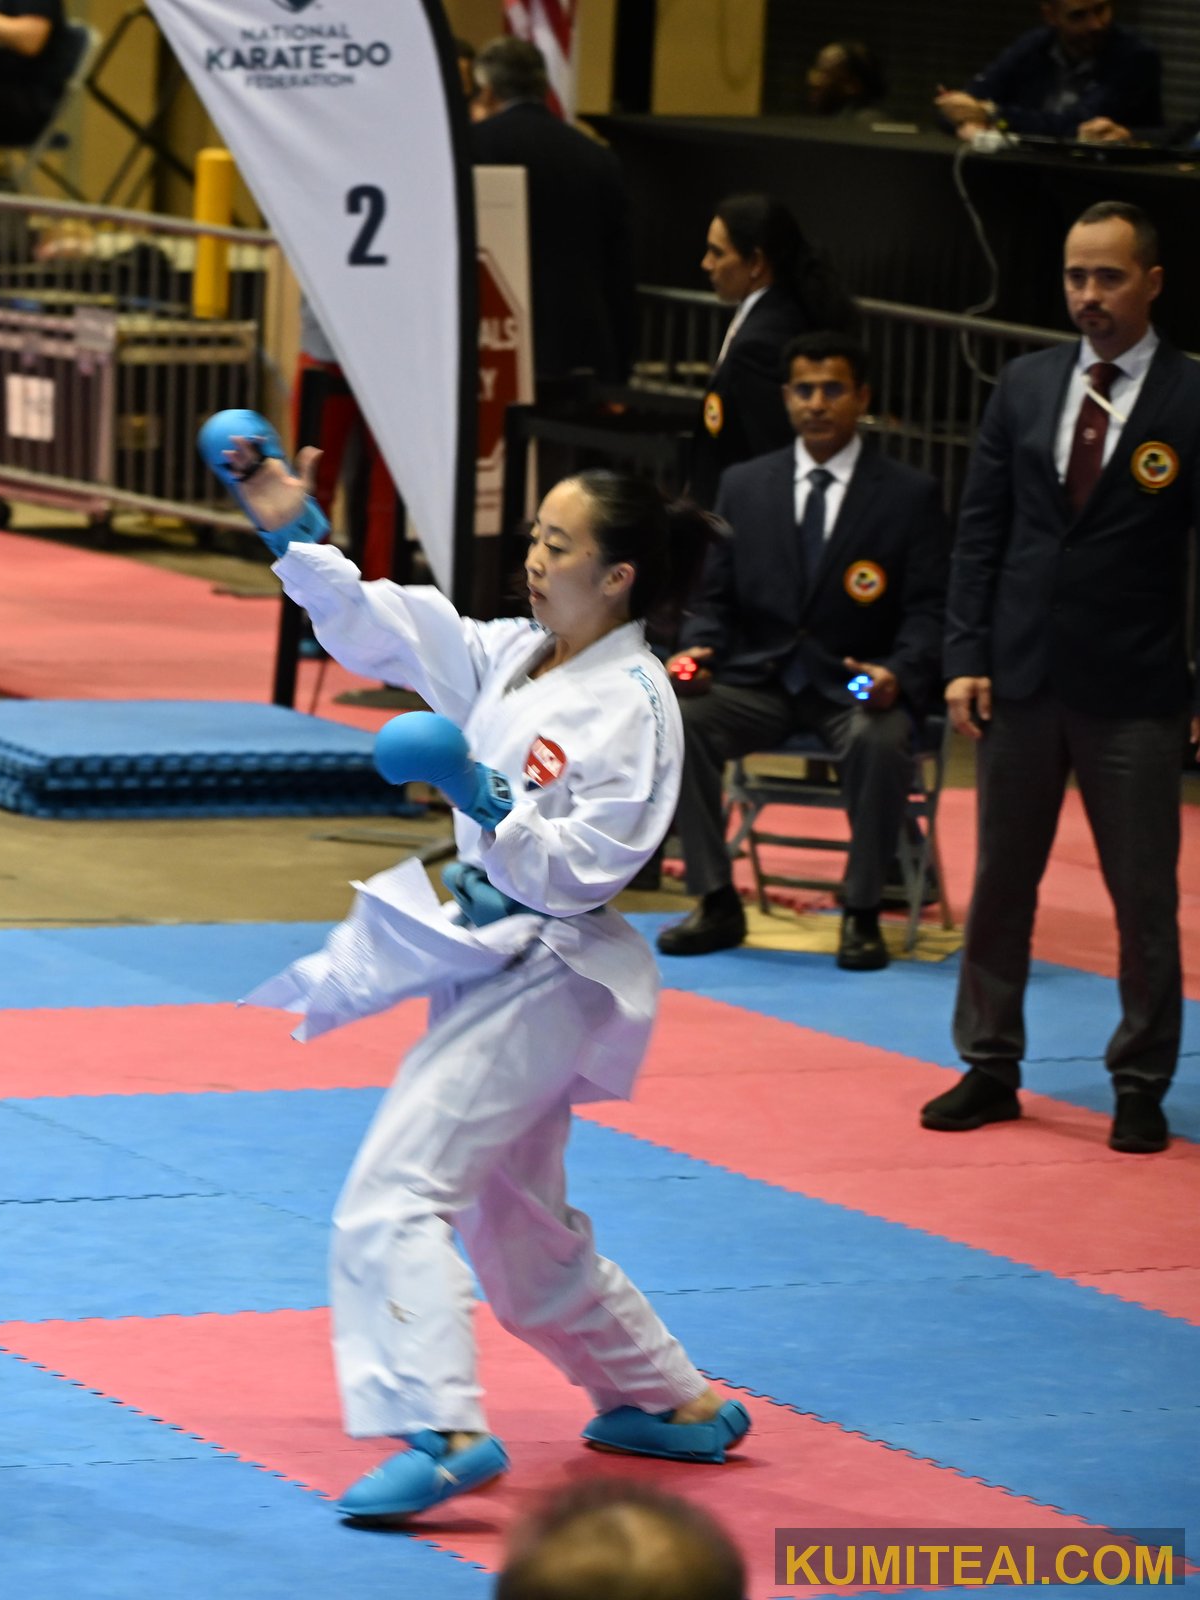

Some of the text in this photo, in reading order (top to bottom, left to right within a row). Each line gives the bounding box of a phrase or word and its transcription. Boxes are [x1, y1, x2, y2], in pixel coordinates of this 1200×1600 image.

[240, 24, 350, 41] NATIONAL
[205, 42, 391, 71] KARATE-DO
[246, 73, 355, 90] FEDERATION
[345, 184, 388, 267] 2
